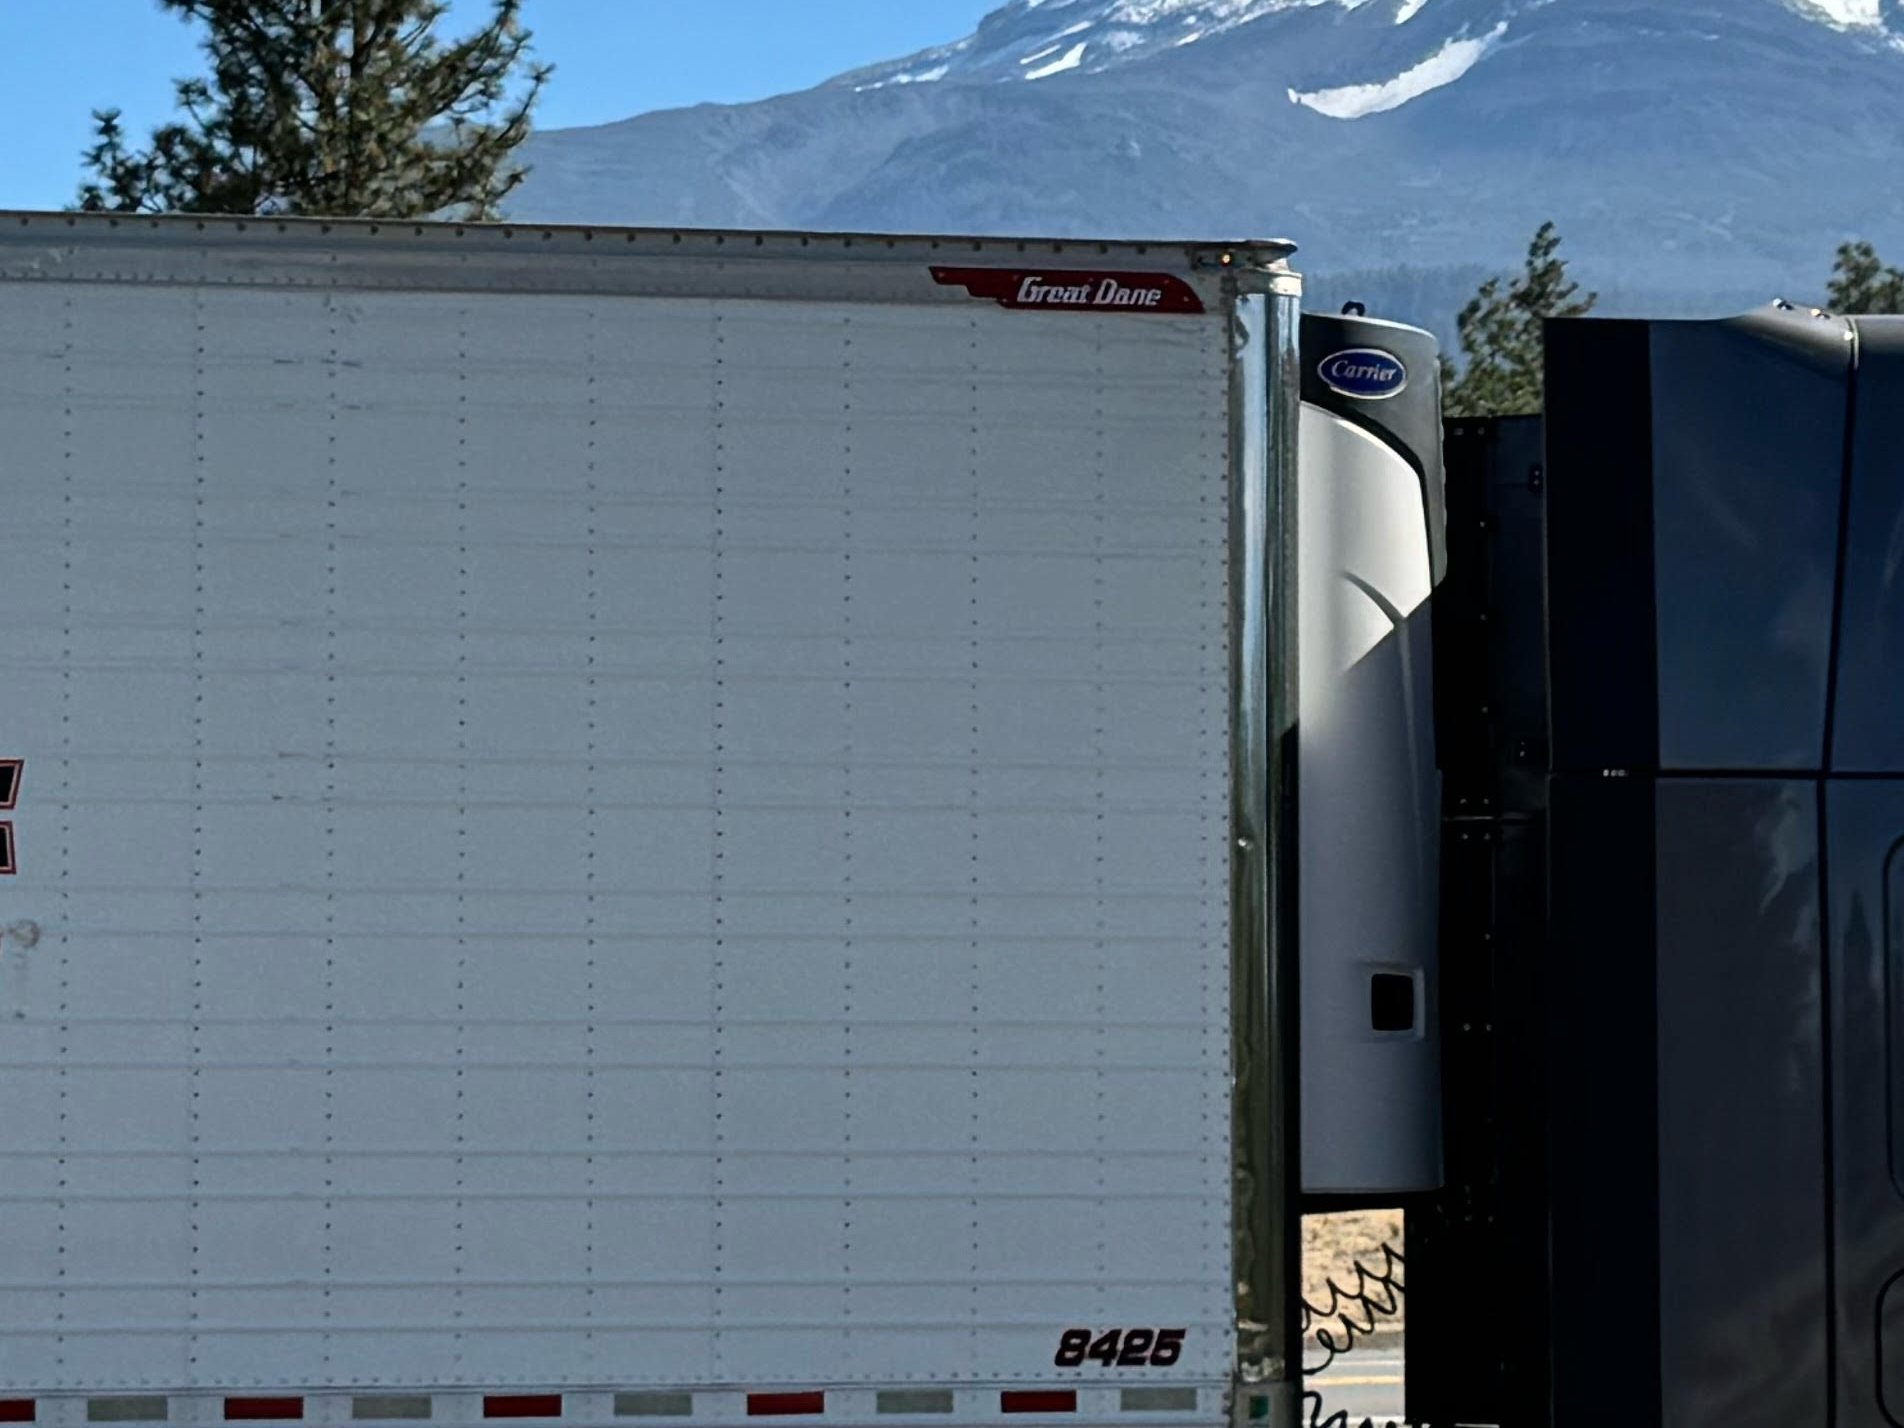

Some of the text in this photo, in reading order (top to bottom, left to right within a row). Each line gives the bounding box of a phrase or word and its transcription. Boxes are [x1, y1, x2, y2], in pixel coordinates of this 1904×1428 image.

[1017, 276, 1163, 307] Great Dane
[1331, 359, 1397, 382] Carrier
[1054, 1328, 1187, 1367] 8425
